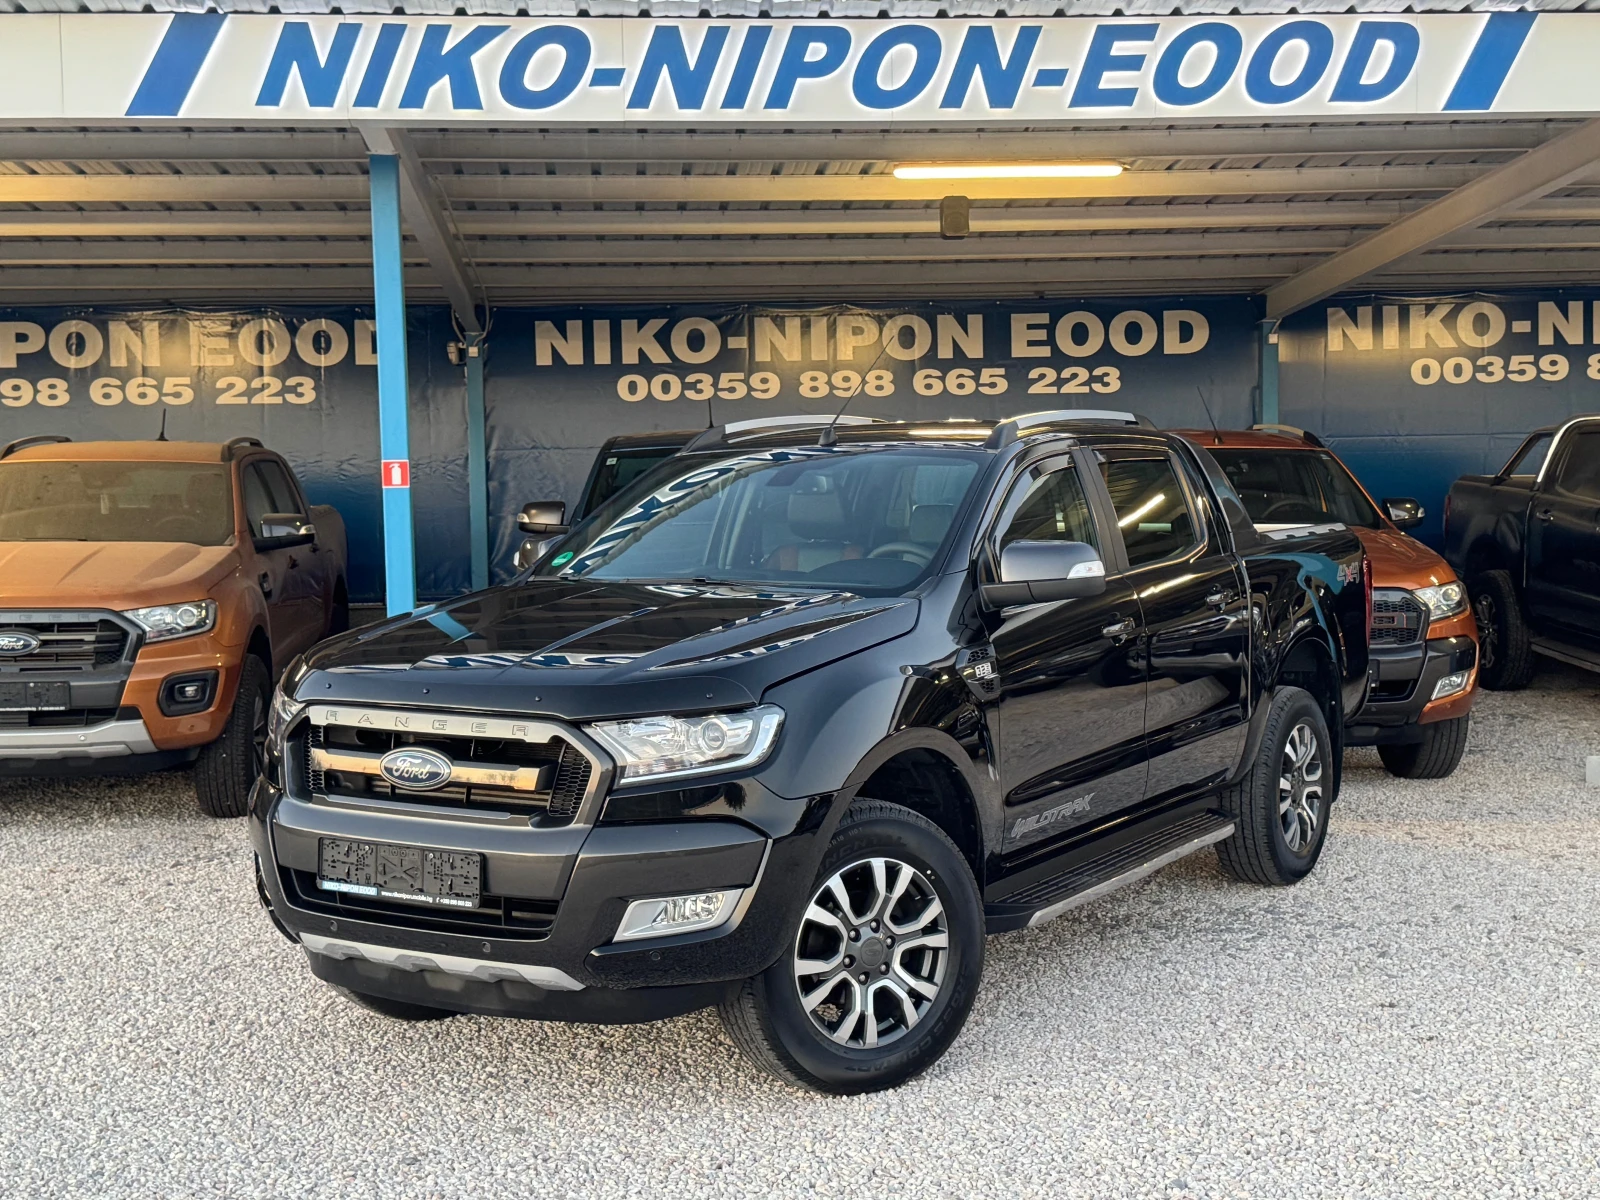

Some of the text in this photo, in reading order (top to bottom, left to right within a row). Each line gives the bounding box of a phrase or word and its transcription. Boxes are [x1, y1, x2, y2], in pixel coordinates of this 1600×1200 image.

[257, 21, 1420, 109] NIKO-NIPON-EOOD
[535, 310, 1210, 367] NIKO-NIPON EOOD
[616, 366, 1122, 403] 00359 898 665 223
[1410, 353, 1570, 385] 00359
[0, 375, 317, 408] 98 665 223
[326, 710, 528, 736] RANGER
[392, 757, 430, 779] Ford
